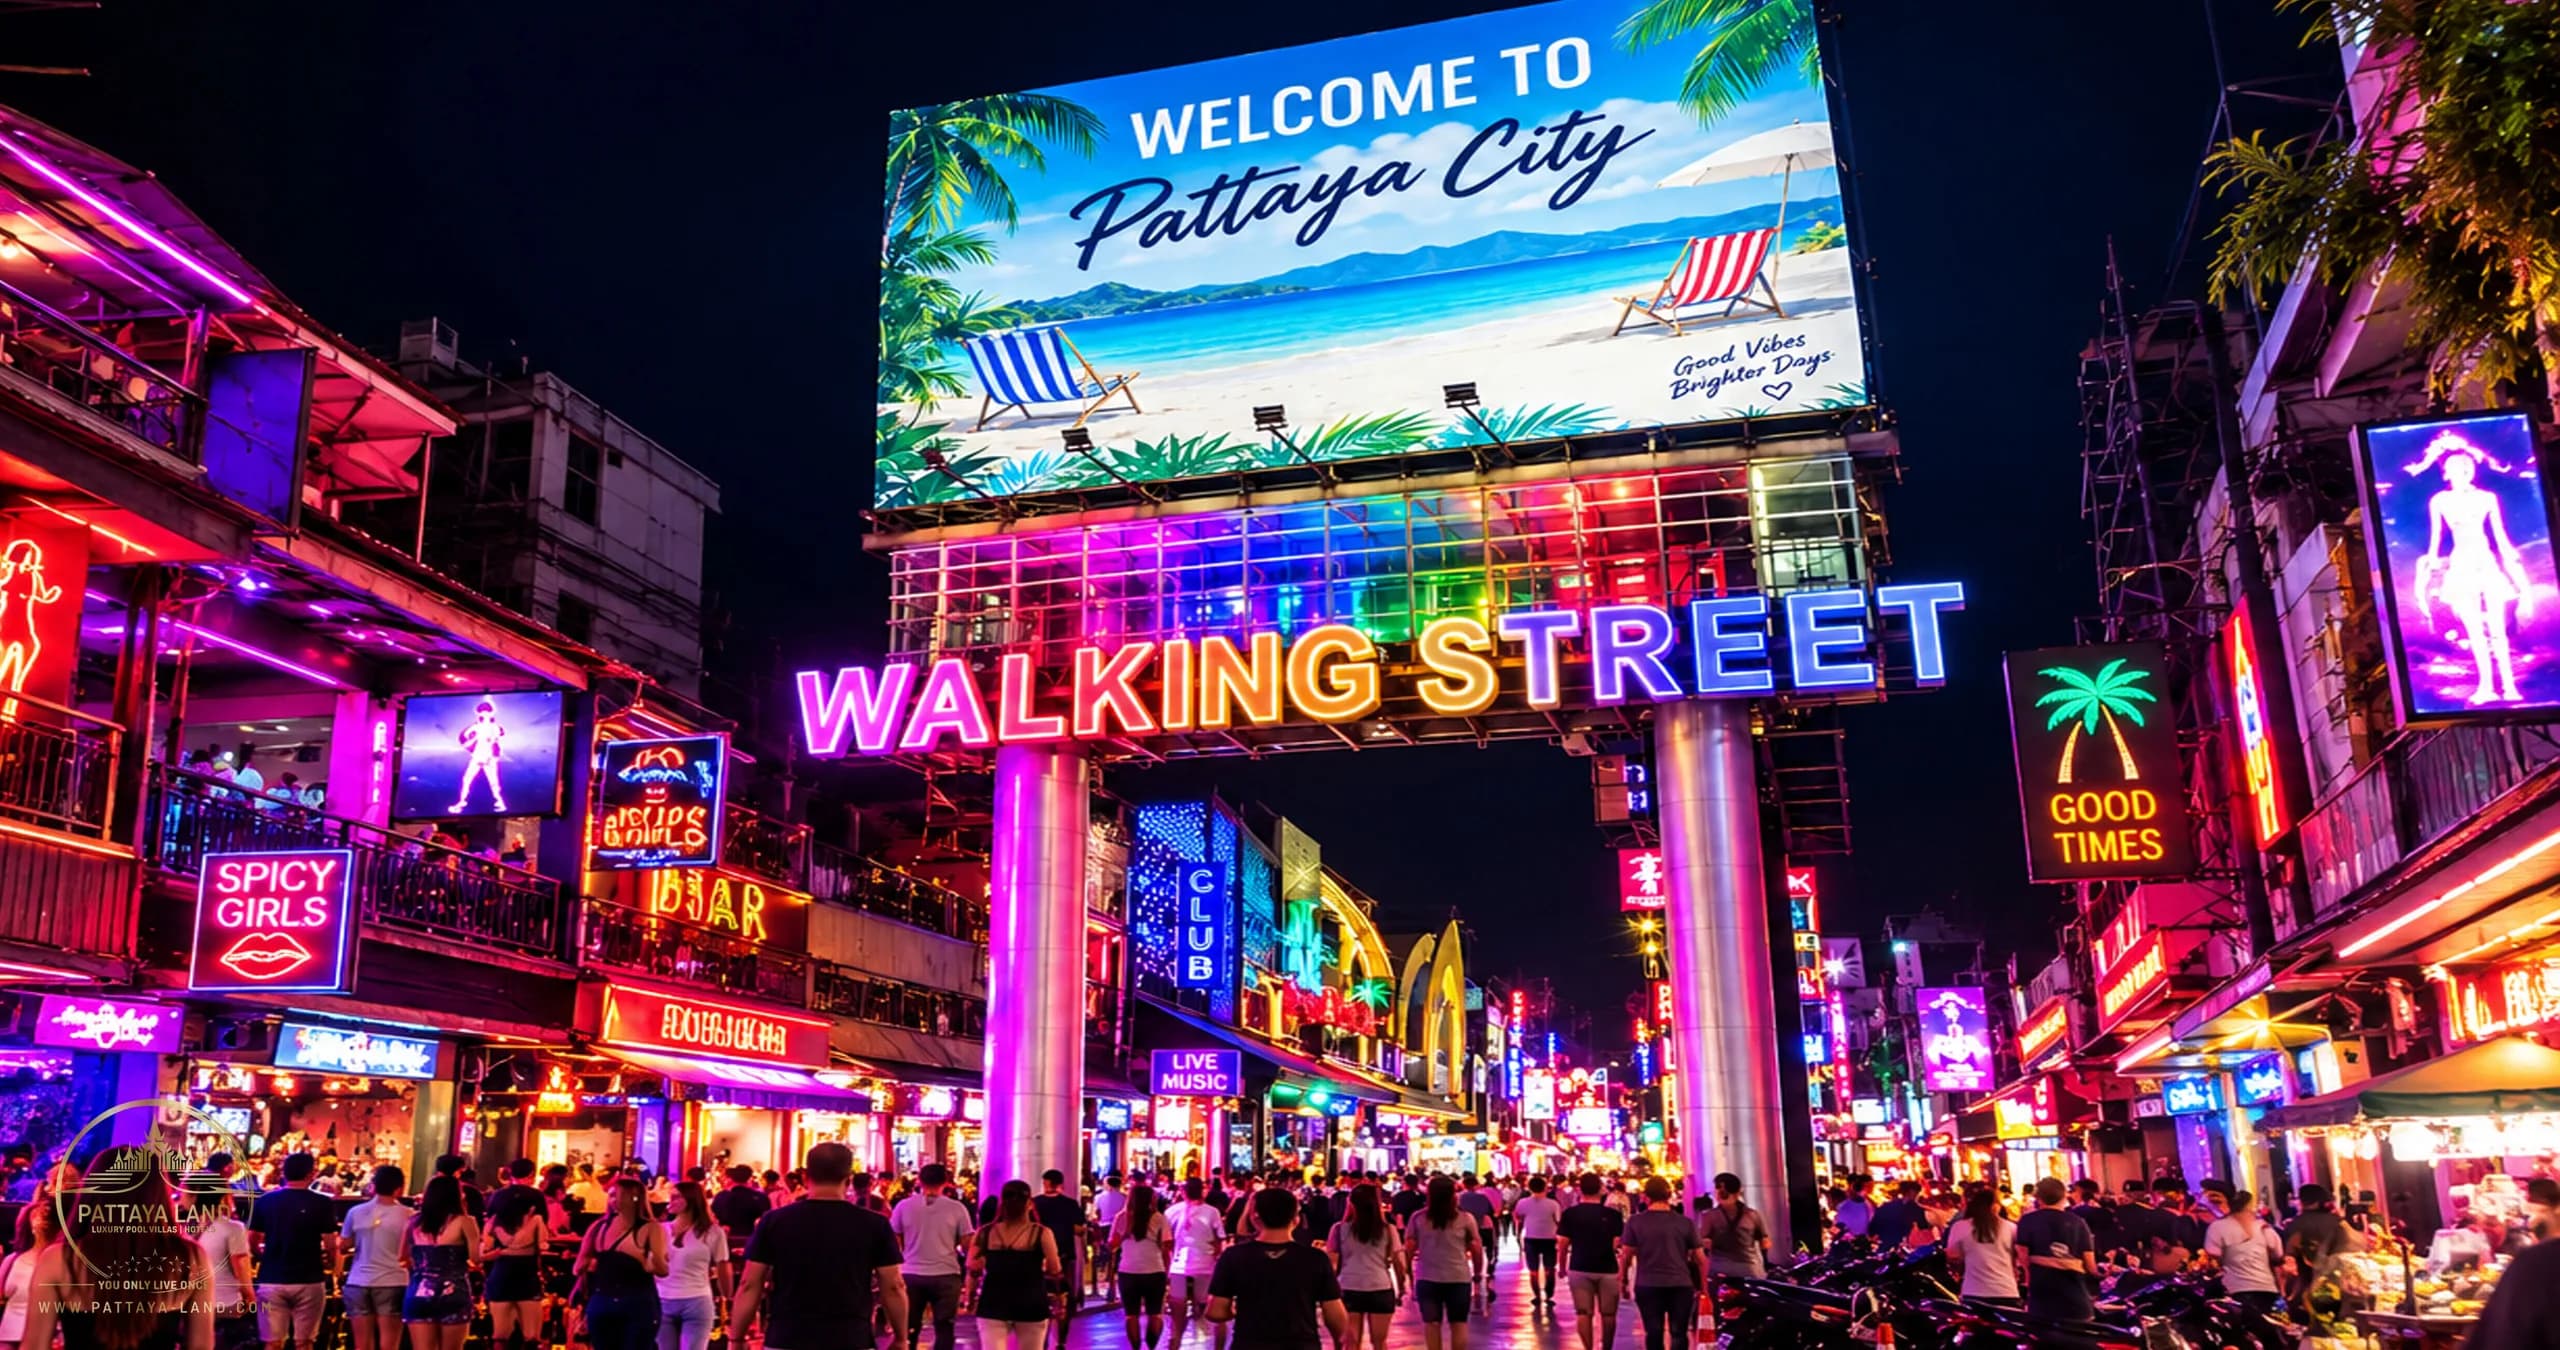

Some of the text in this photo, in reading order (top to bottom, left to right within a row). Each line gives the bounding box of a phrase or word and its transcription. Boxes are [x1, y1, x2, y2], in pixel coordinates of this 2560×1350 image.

[1130, 36, 1592, 159] WELCOME TO
[1069, 109, 1656, 272] Pattaya City
[1673, 333, 1806, 376] Good Vibes
[796, 582, 1965, 758] WALKING STREET
[2051, 789, 2157, 825] GOOD
[2053, 828, 2164, 864] TIMES
[216, 859, 337, 893] SPICY
[216, 896, 327, 928] GIRLS
[1188, 868, 1215, 981] CLUB
[1172, 1053, 1219, 1071] LIVE
[1161, 1073, 1228, 1091] MUSIC
